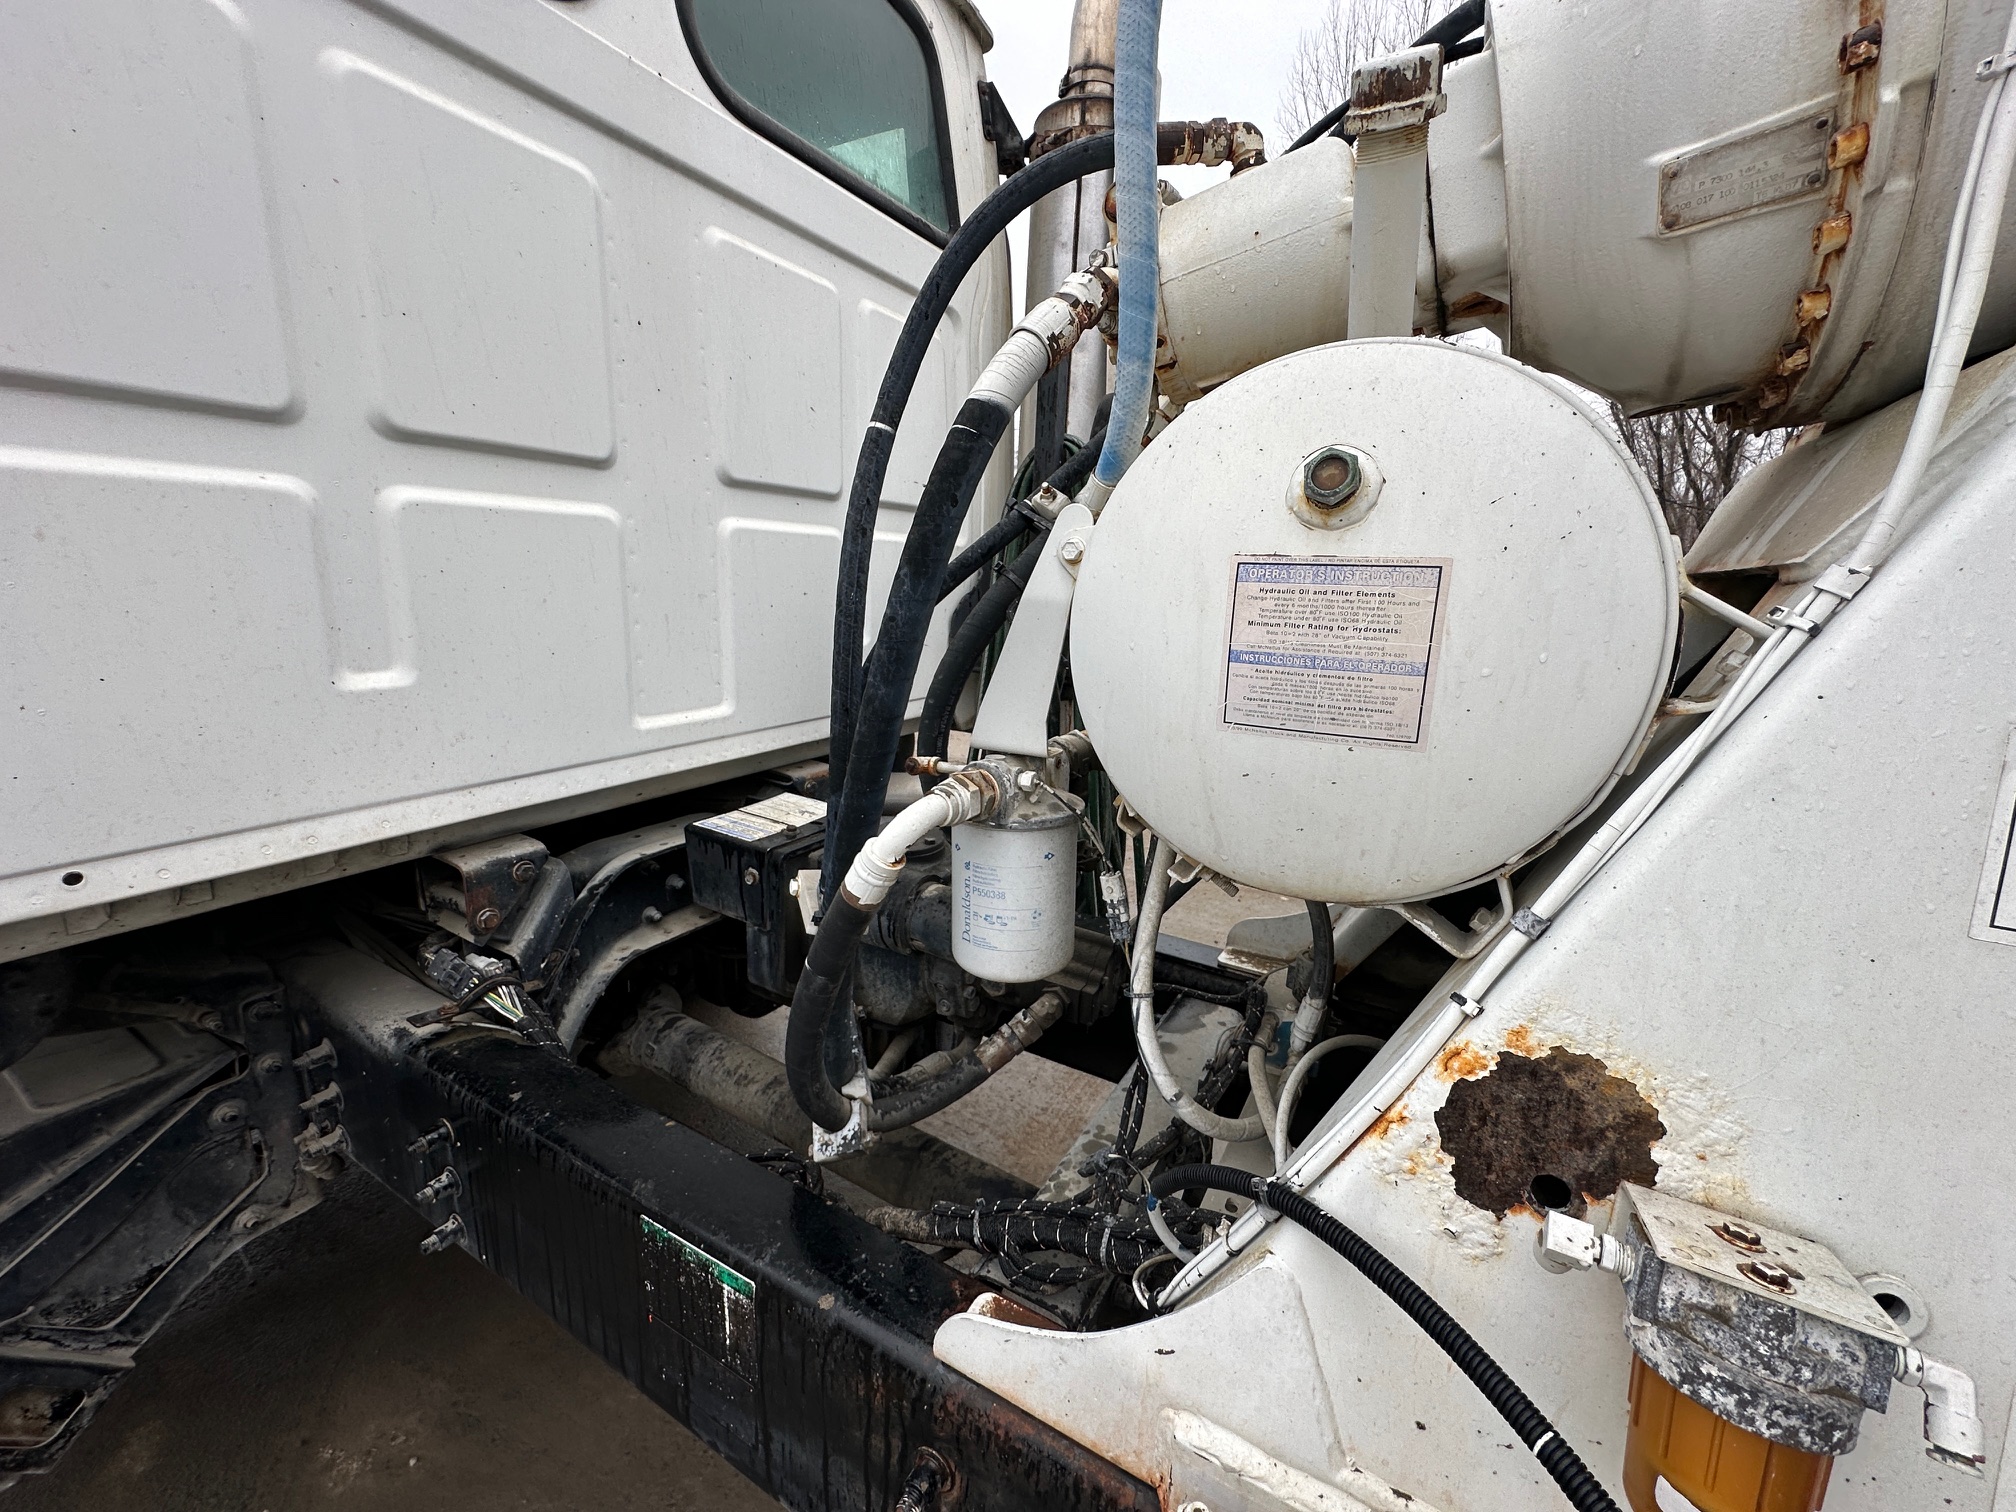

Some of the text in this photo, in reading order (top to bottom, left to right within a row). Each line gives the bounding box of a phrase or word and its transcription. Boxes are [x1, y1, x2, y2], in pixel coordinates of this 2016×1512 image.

[1249, 568, 1326, 579] OPERATOR'S
[1247, 620, 1280, 628] Minimum
[1307, 623, 1333, 631] Rating
[1352, 625, 1401, 635] Hydrostats:
[1239, 653, 1311, 665] INSTRUCCIONES
[1314, 658, 1340, 667] PARA
[1358, 661, 1412, 672] OPERADOR
[1242, 695, 1270, 703] Capacidad
[1298, 733, 1338, 742] Manufacturing
